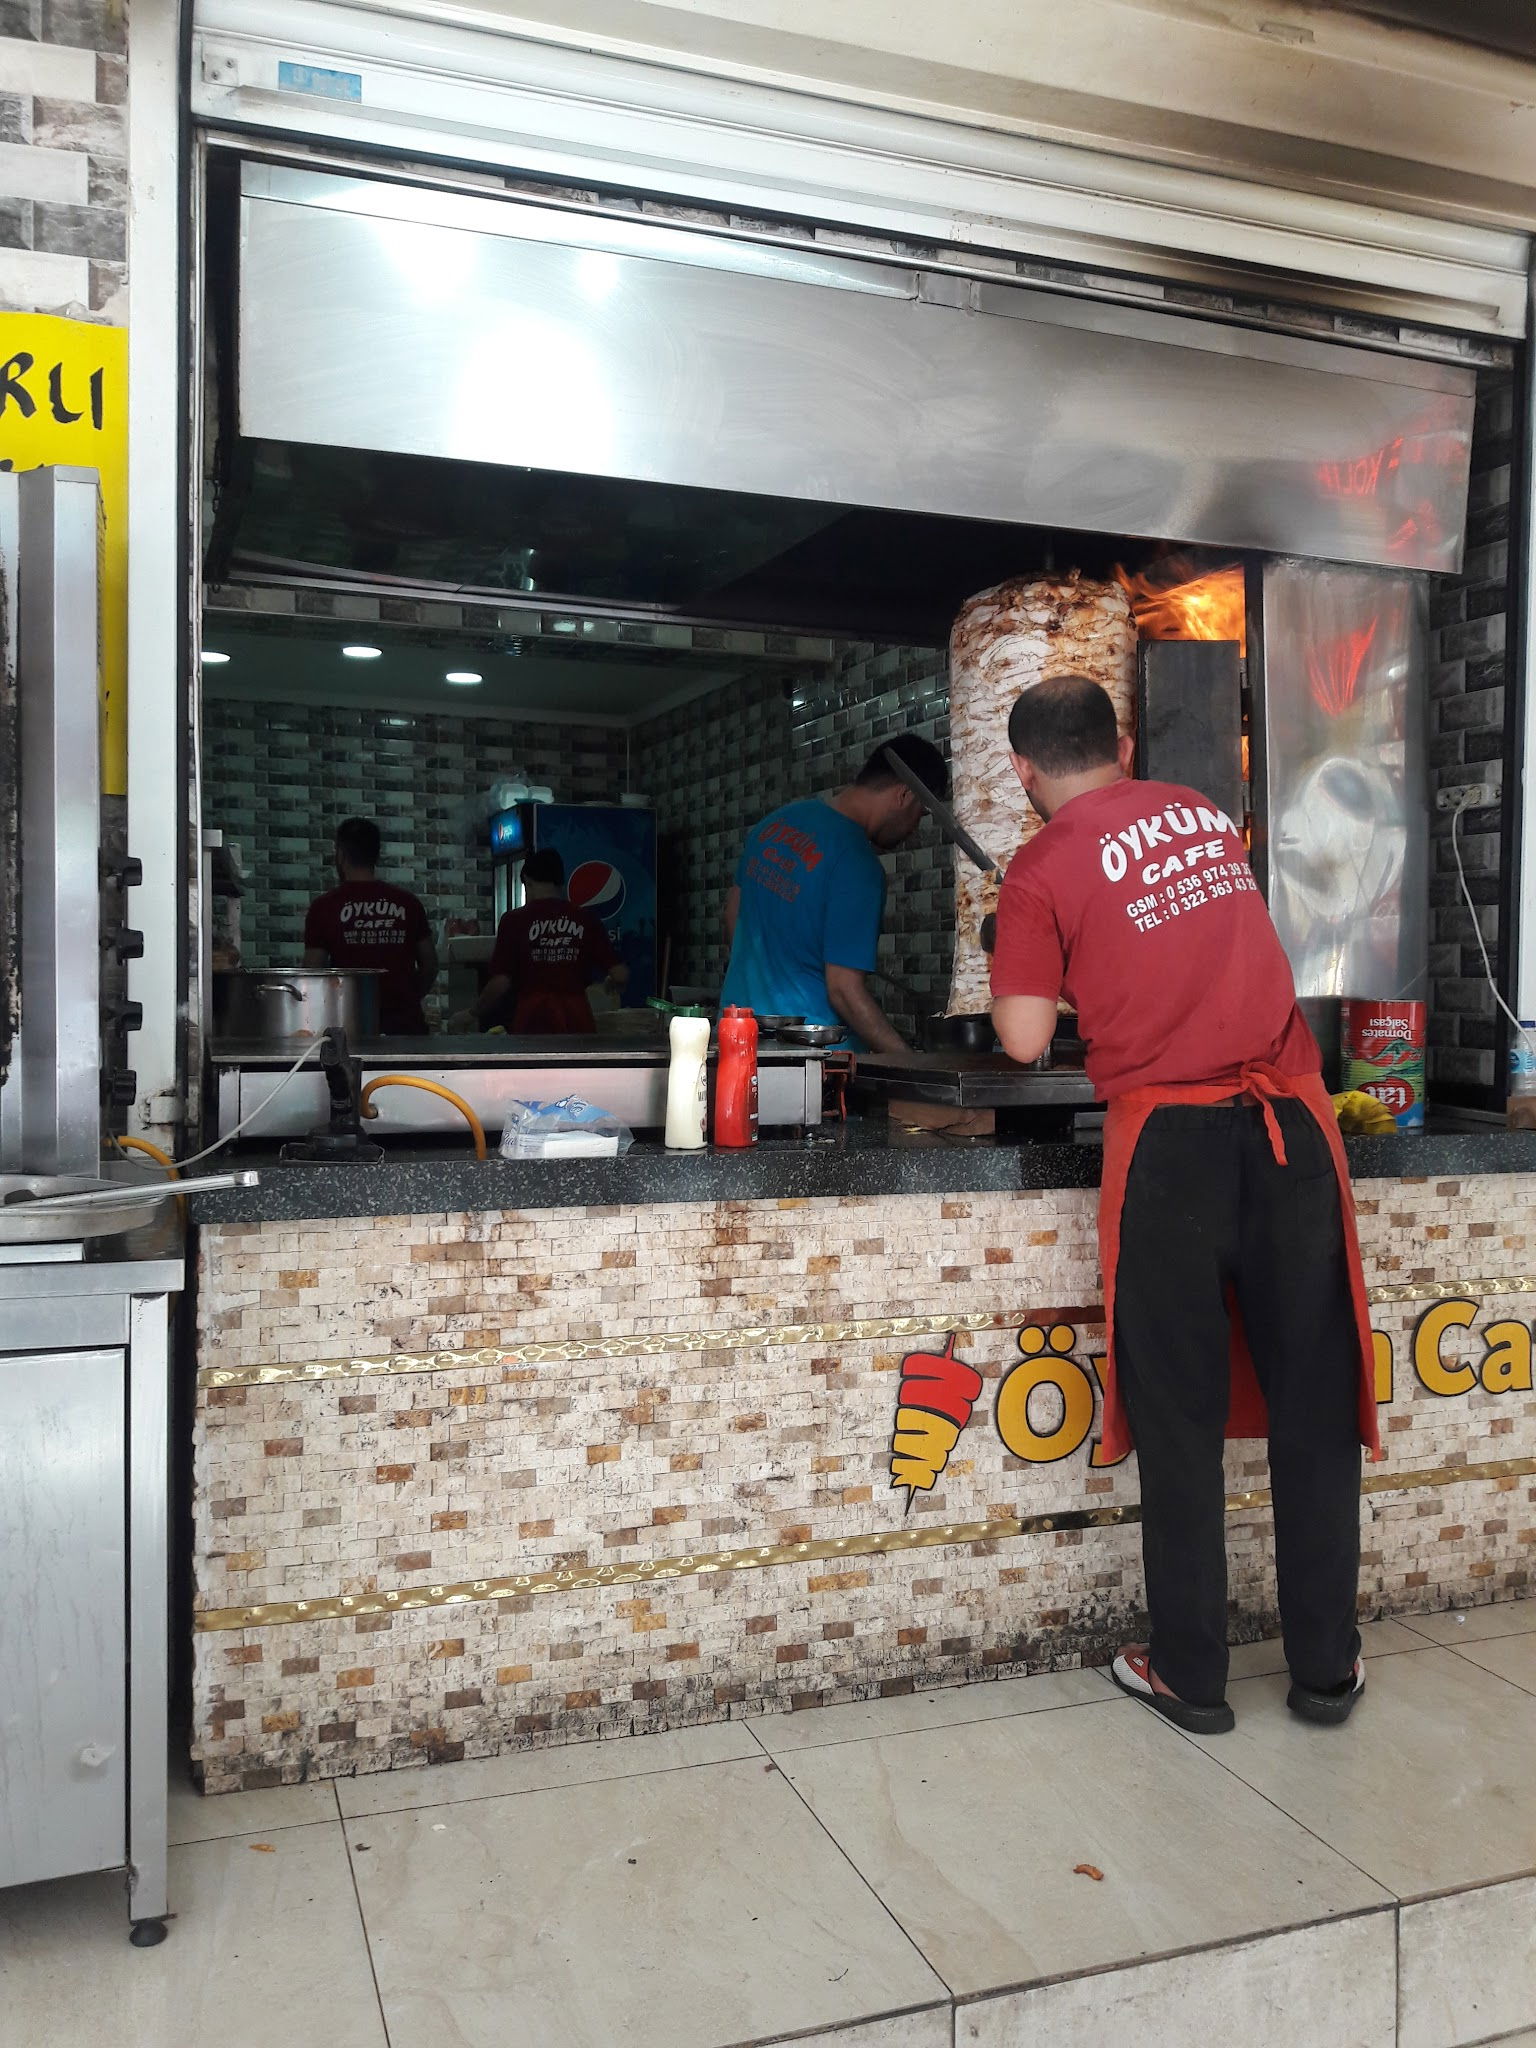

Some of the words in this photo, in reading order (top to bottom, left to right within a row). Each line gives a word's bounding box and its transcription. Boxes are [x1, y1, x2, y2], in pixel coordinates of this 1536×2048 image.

[1100, 803, 1240, 883] ÖYKÜM
[1142, 839, 1226, 885] CAFE
[1126, 893, 1159, 918] GSM
[1166, 885, 1176, 900] 0
[1177, 874, 1203, 895] 536
[1203, 864, 1229, 883] 974
[1228, 862, 1242, 875] 39
[340, 898, 406, 922] ÖYKÜM
[1134, 911, 1163, 933] TEL
[1170, 902, 1181, 916] 0
[1180, 889, 1209, 911] 322
[1208, 880, 1233, 899] 363
[1234, 877, 1247, 891] 43
[354, 919, 396, 928] CAFE
[528, 915, 584, 941] ÖYKÜM
[540, 936, 573, 946] CAFE
[1361, 1029, 1413, 1041] Domates
[1370, 1016, 1409, 1030] Salçası
[1413, 1297, 1536, 1397] Ca
